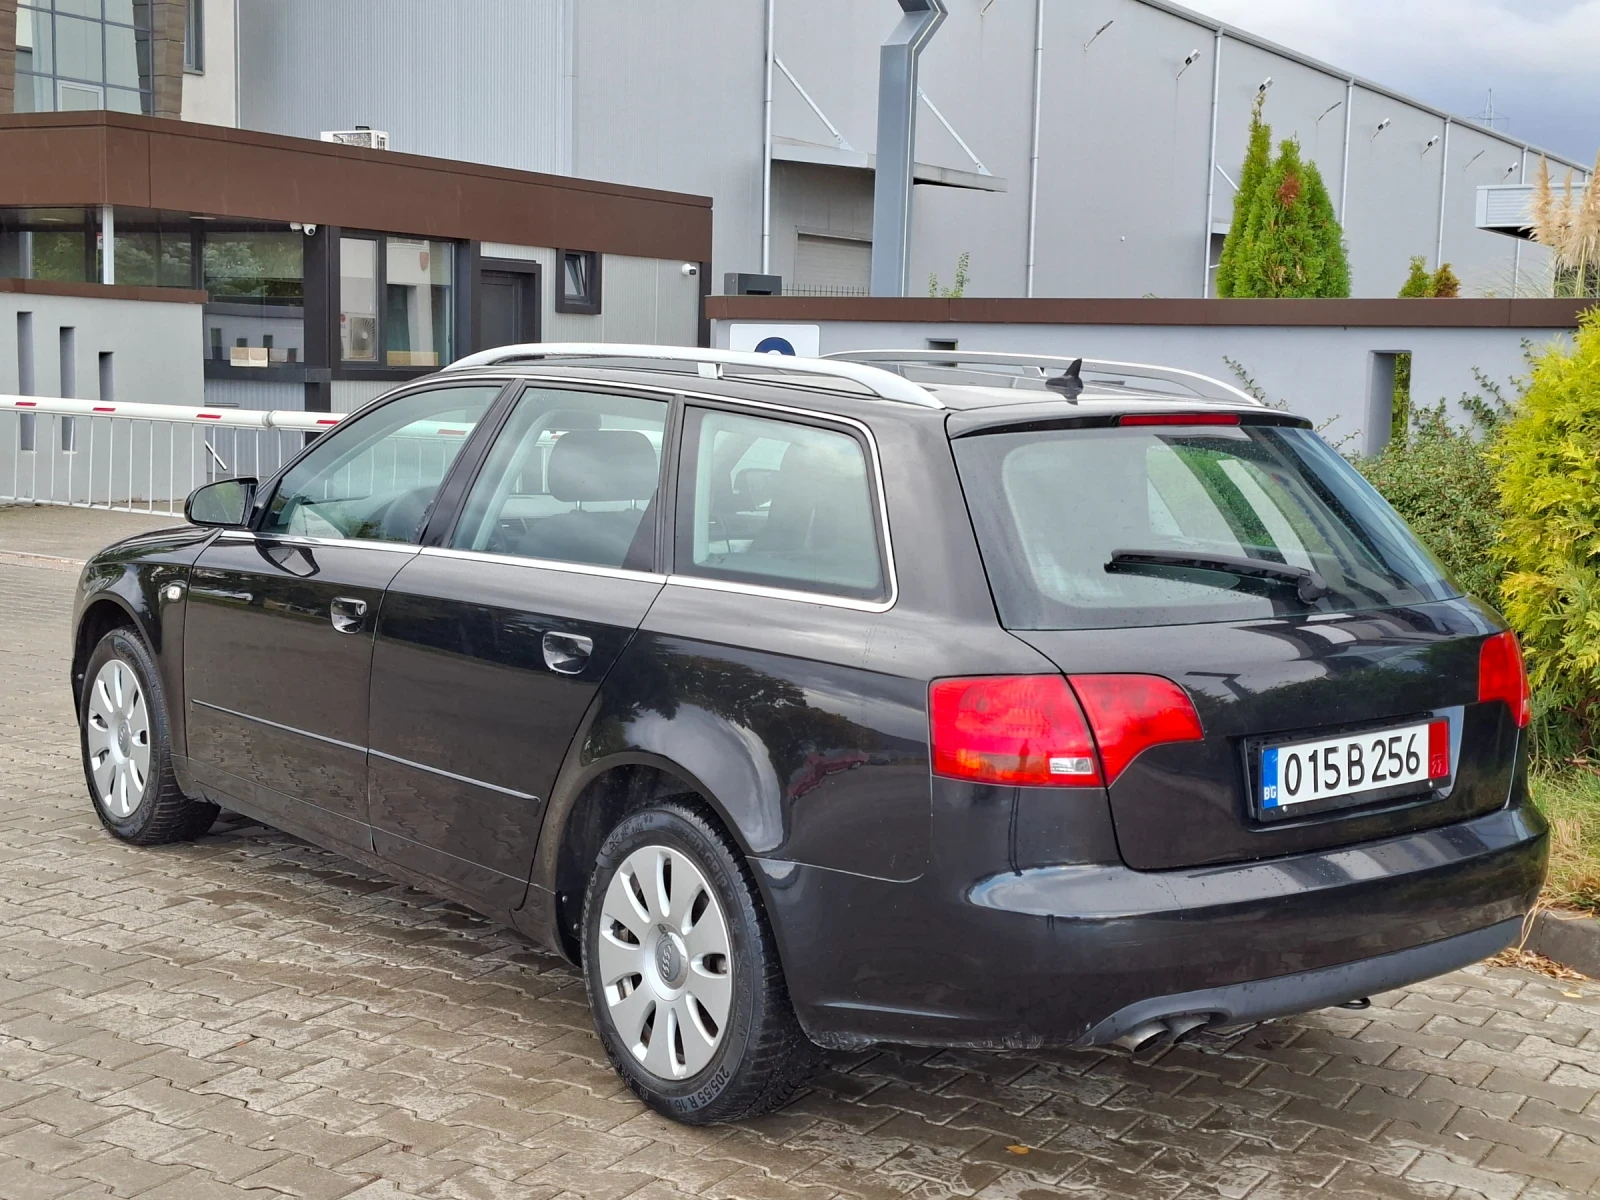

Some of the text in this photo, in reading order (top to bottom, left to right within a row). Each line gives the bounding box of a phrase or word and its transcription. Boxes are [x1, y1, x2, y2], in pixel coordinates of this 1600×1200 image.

[1264, 785, 1277, 800] BG
[1284, 733, 1421, 796] 015B256
[697, 1064, 730, 1105] 205/55
[674, 1099, 688, 1112] 16
[687, 1095, 699, 1109] R
